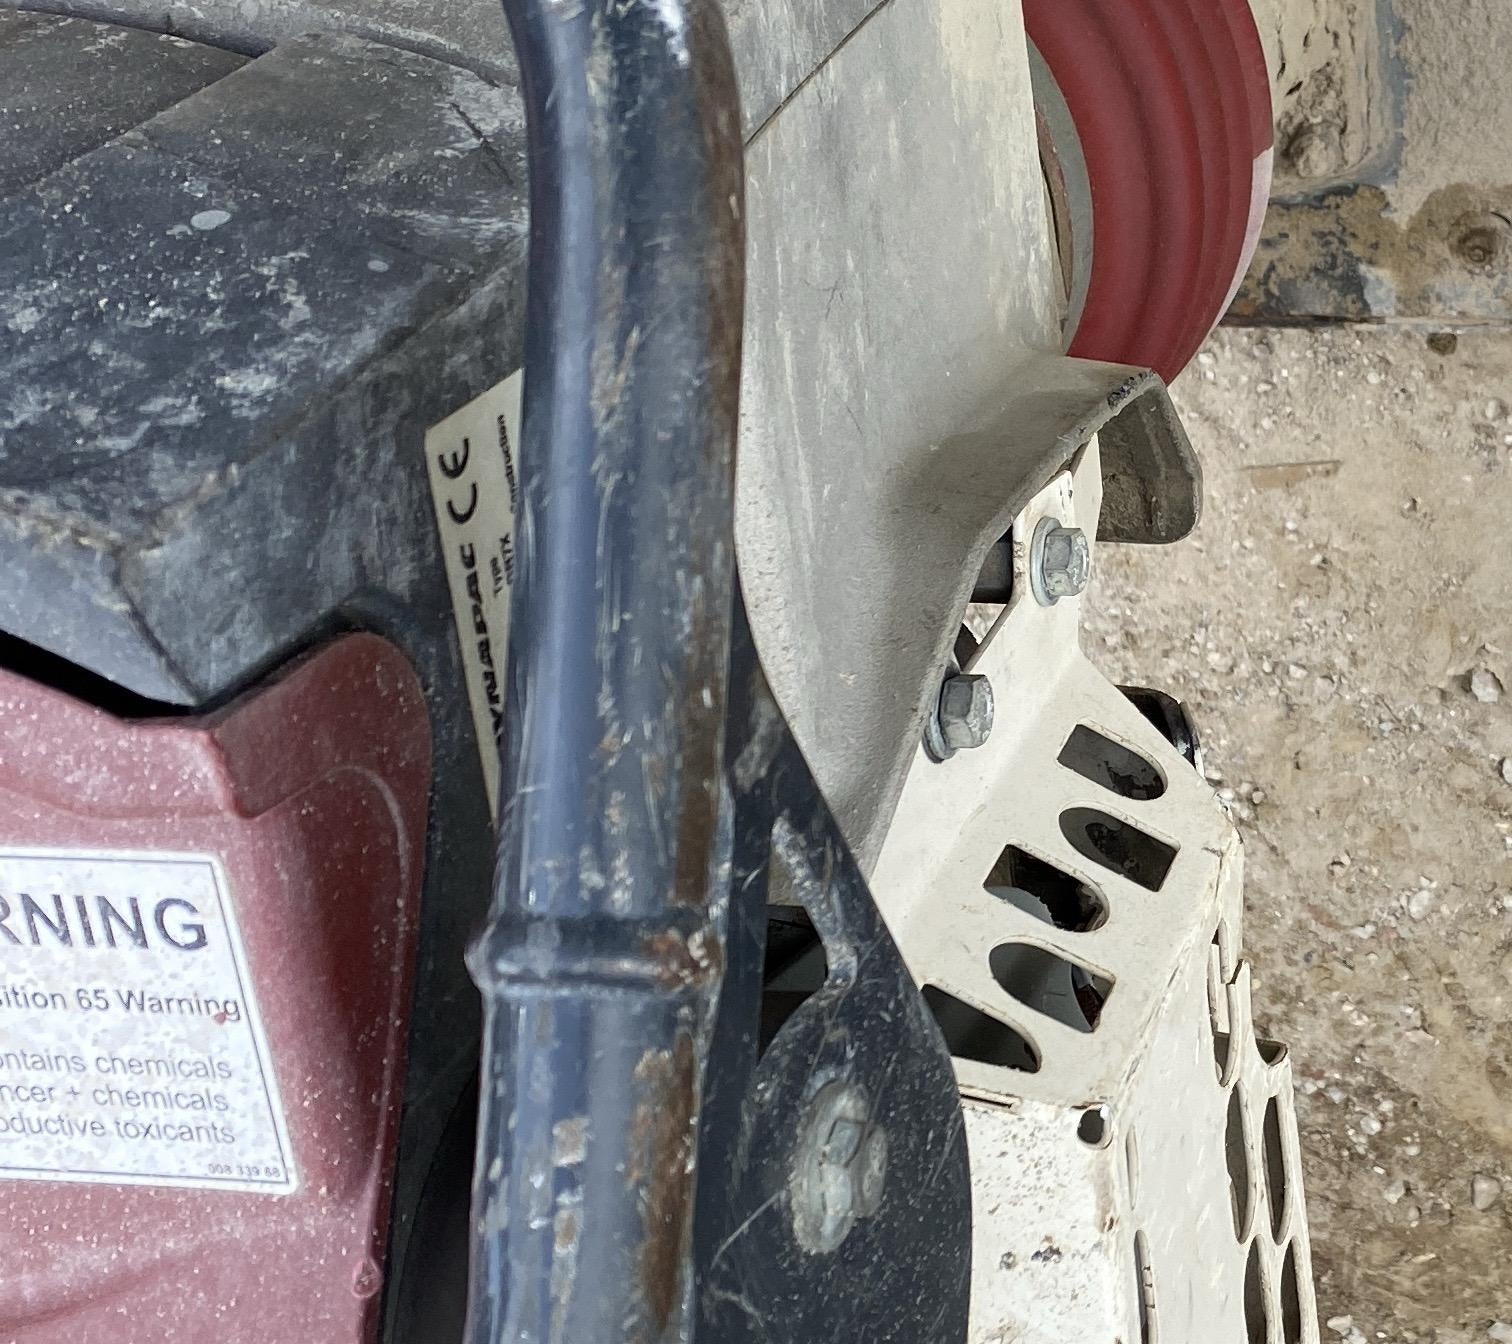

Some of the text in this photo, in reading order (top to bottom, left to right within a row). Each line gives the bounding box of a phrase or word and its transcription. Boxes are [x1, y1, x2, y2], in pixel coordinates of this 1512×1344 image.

[76, 988, 110, 1012] 65
[115, 989, 242, 1022] Warning
[96, 1053, 232, 1079] chemicals
[92, 1083, 229, 1112] chemicals
[113, 1120, 235, 1144] toxicants
